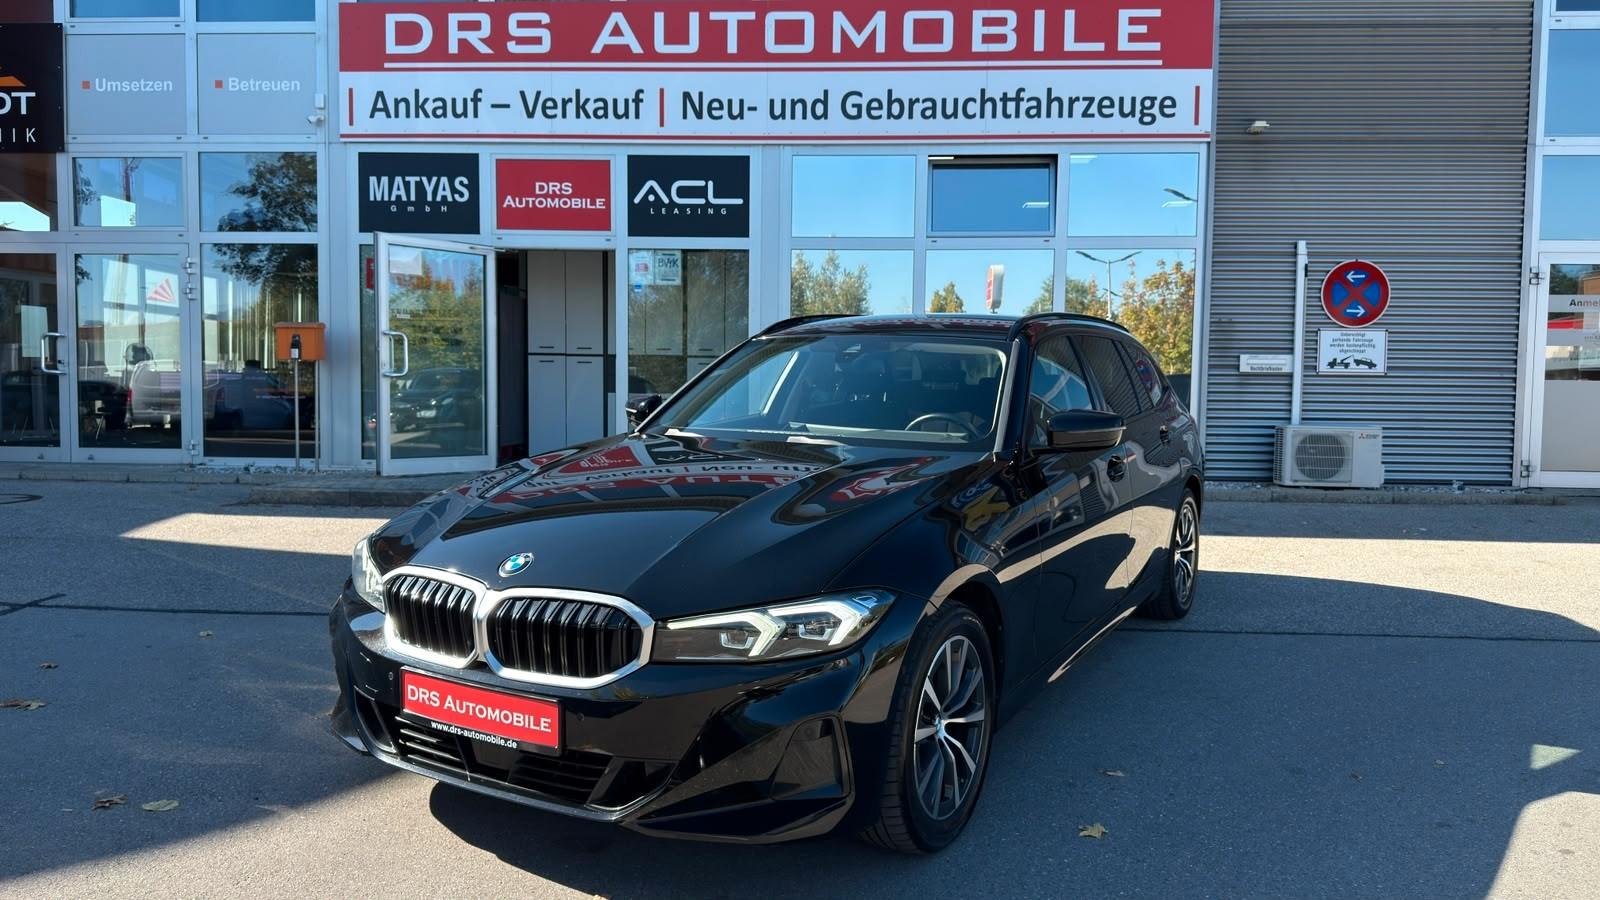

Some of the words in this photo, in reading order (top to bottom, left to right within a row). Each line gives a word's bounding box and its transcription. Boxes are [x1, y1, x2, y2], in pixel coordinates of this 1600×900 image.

[385, 12, 552, 54] DRS
[590, 9, 1162, 54] AUTOMOBILE
[95, 78, 173, 92] Umsetzen
[228, 77, 301, 92] Betreuen
[369, 88, 483, 119] Ankauf
[519, 88, 645, 120] Verkauf
[682, 91, 757, 120] Neu-
[769, 89, 829, 120] und
[840, 87, 1178, 126] Gebrauchtfahrzeuge
[0, 127, 36, 143] IK
[369, 176, 470, 202] MATYAS
[535, 182, 572, 195] DRS
[633, 179, 744, 204] ACL
[503, 195, 606, 209] AUTOMOBILE
[650, 207, 727, 215] LEASING
[407, 684, 440, 708] DRS
[444, 695, 552, 733] AUTOMOBILE
[431, 720, 518, 749] www.drs-automobile.de
